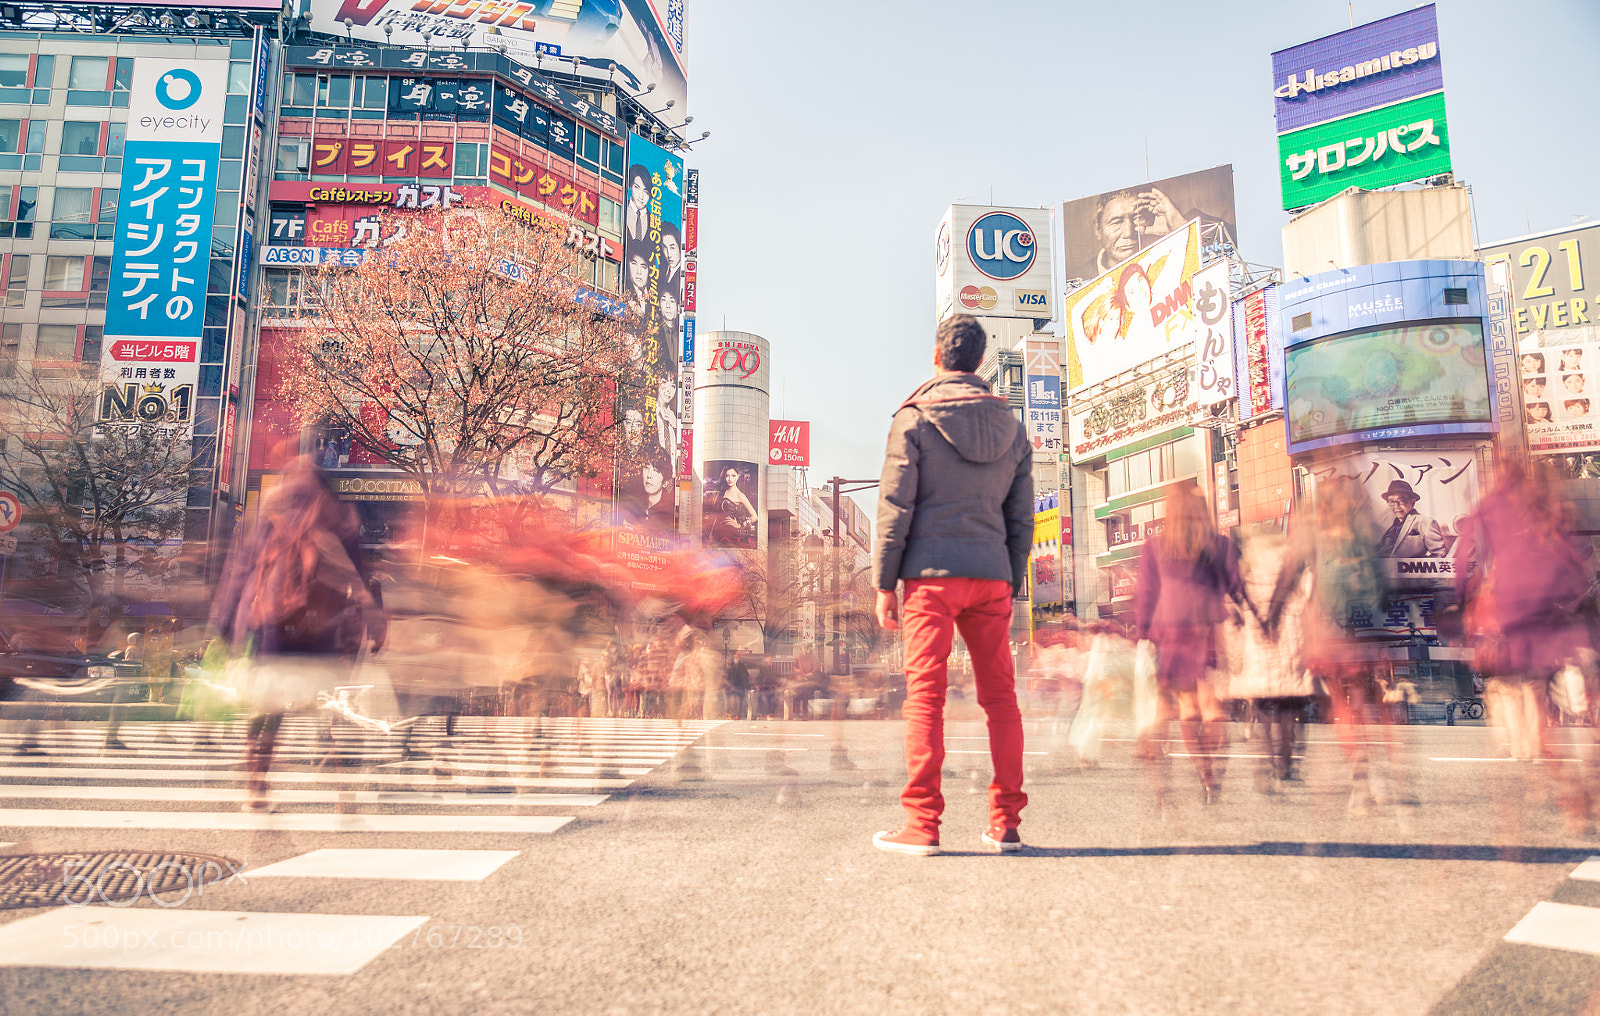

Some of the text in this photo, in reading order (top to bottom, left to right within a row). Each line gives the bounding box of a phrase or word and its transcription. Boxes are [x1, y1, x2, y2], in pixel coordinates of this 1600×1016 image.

[486, 35, 518, 46] SANKYO
[1273, 41, 1437, 98] Hisamitsu
[505, 88, 516, 98] 9F
[140, 115, 211, 133] eyecity
[315, 142, 450, 170] プライス
[1285, 118, 1441, 181] サロンパス
[490, 150, 597, 217] コンタクト
[396, 184, 462, 208] ガスト
[272, 218, 304, 238] 7F
[312, 219, 348, 234] Café
[122, 158, 172, 321] アイシティ
[166, 159, 206, 321] コンタクトの
[567, 224, 614, 258] ガスト
[266, 249, 315, 264] AEON
[1316, 275, 1357, 290] Channel
[686, 282, 695, 306] ガスト
[960, 292, 998, 302] MasterCard
[1018, 294, 1047, 305] VISA
[1150, 280, 1192, 328] DMM
[1348, 305, 1404, 319] PLATINUM
[718, 341, 760, 352] SHIBUYA
[1196, 281, 1232, 396] もんじゃ
[119, 343, 190, 360] 当ビル5階
[706, 347, 761, 379] 109
[120, 367, 176, 380] 利用者数
[683, 376, 692, 419] 渋谷駅前ビル
[1494, 361, 1515, 423] neon
[100, 383, 193, 425] No.1
[1030, 410, 1060, 421] 夜11時
[1036, 422, 1055, 433] まで
[1045, 438, 1061, 449] 地下
